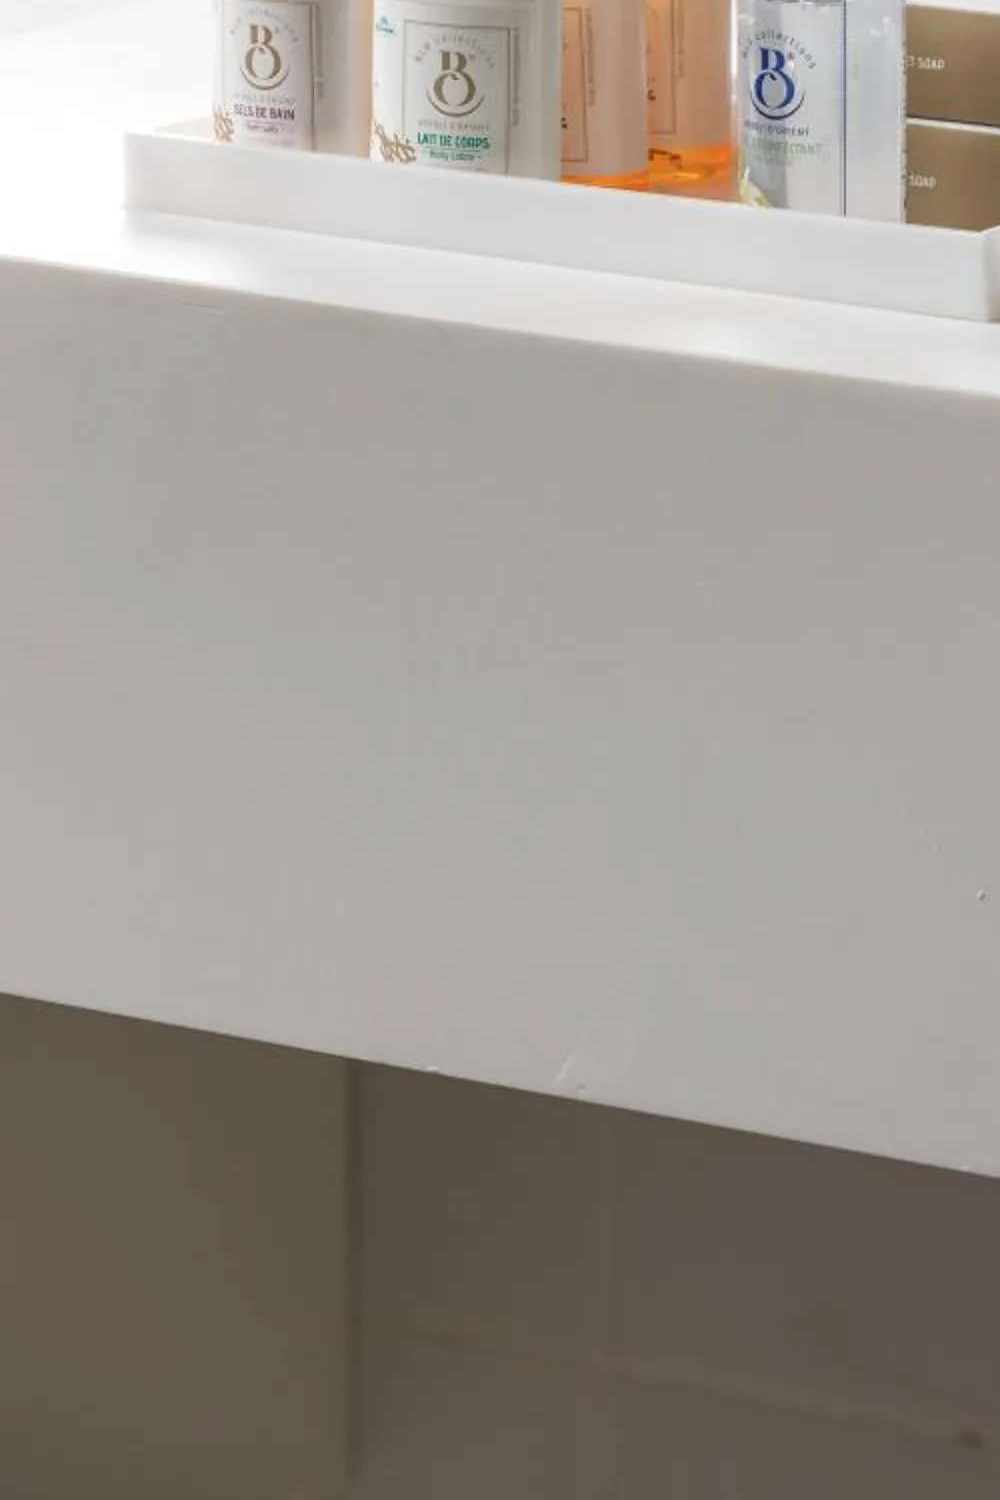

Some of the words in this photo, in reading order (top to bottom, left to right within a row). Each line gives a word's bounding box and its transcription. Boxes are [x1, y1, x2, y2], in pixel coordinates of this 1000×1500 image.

[917, 56, 945, 71] SOAP
[255, 105, 268, 119] DE
[269, 106, 296, 121] BAIN
[417, 132, 437, 146] LAIT
[439, 134, 453, 147] DE
[455, 135, 491, 150] CORPS
[908, 174, 937, 189] SOAP
